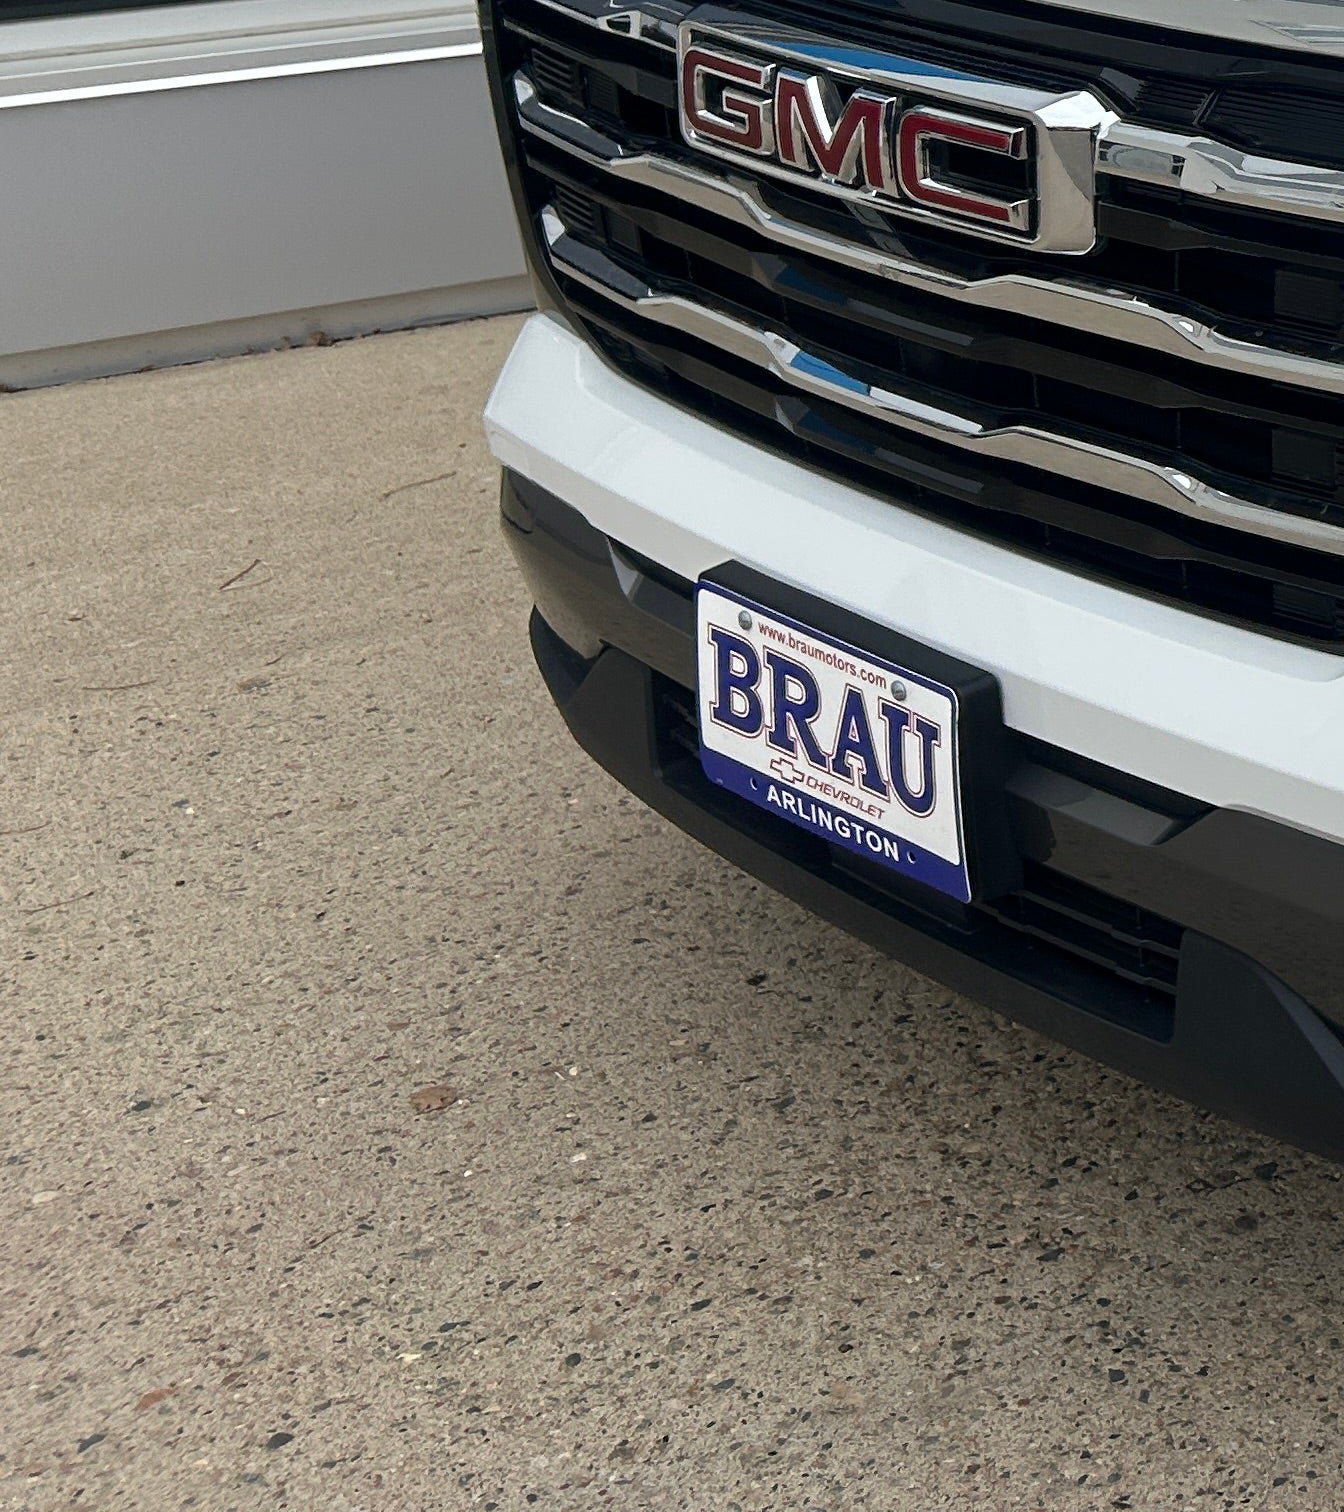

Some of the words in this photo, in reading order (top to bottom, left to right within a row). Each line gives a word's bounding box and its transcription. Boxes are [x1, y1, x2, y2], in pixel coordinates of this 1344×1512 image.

[680, 45, 1030, 231] GMC
[758, 621, 887, 690] www.braumotors.com
[707, 622, 941, 818] BRAU
[766, 784, 899, 862] ARLINGTON
[805, 776, 885, 821] CHEVROLET
